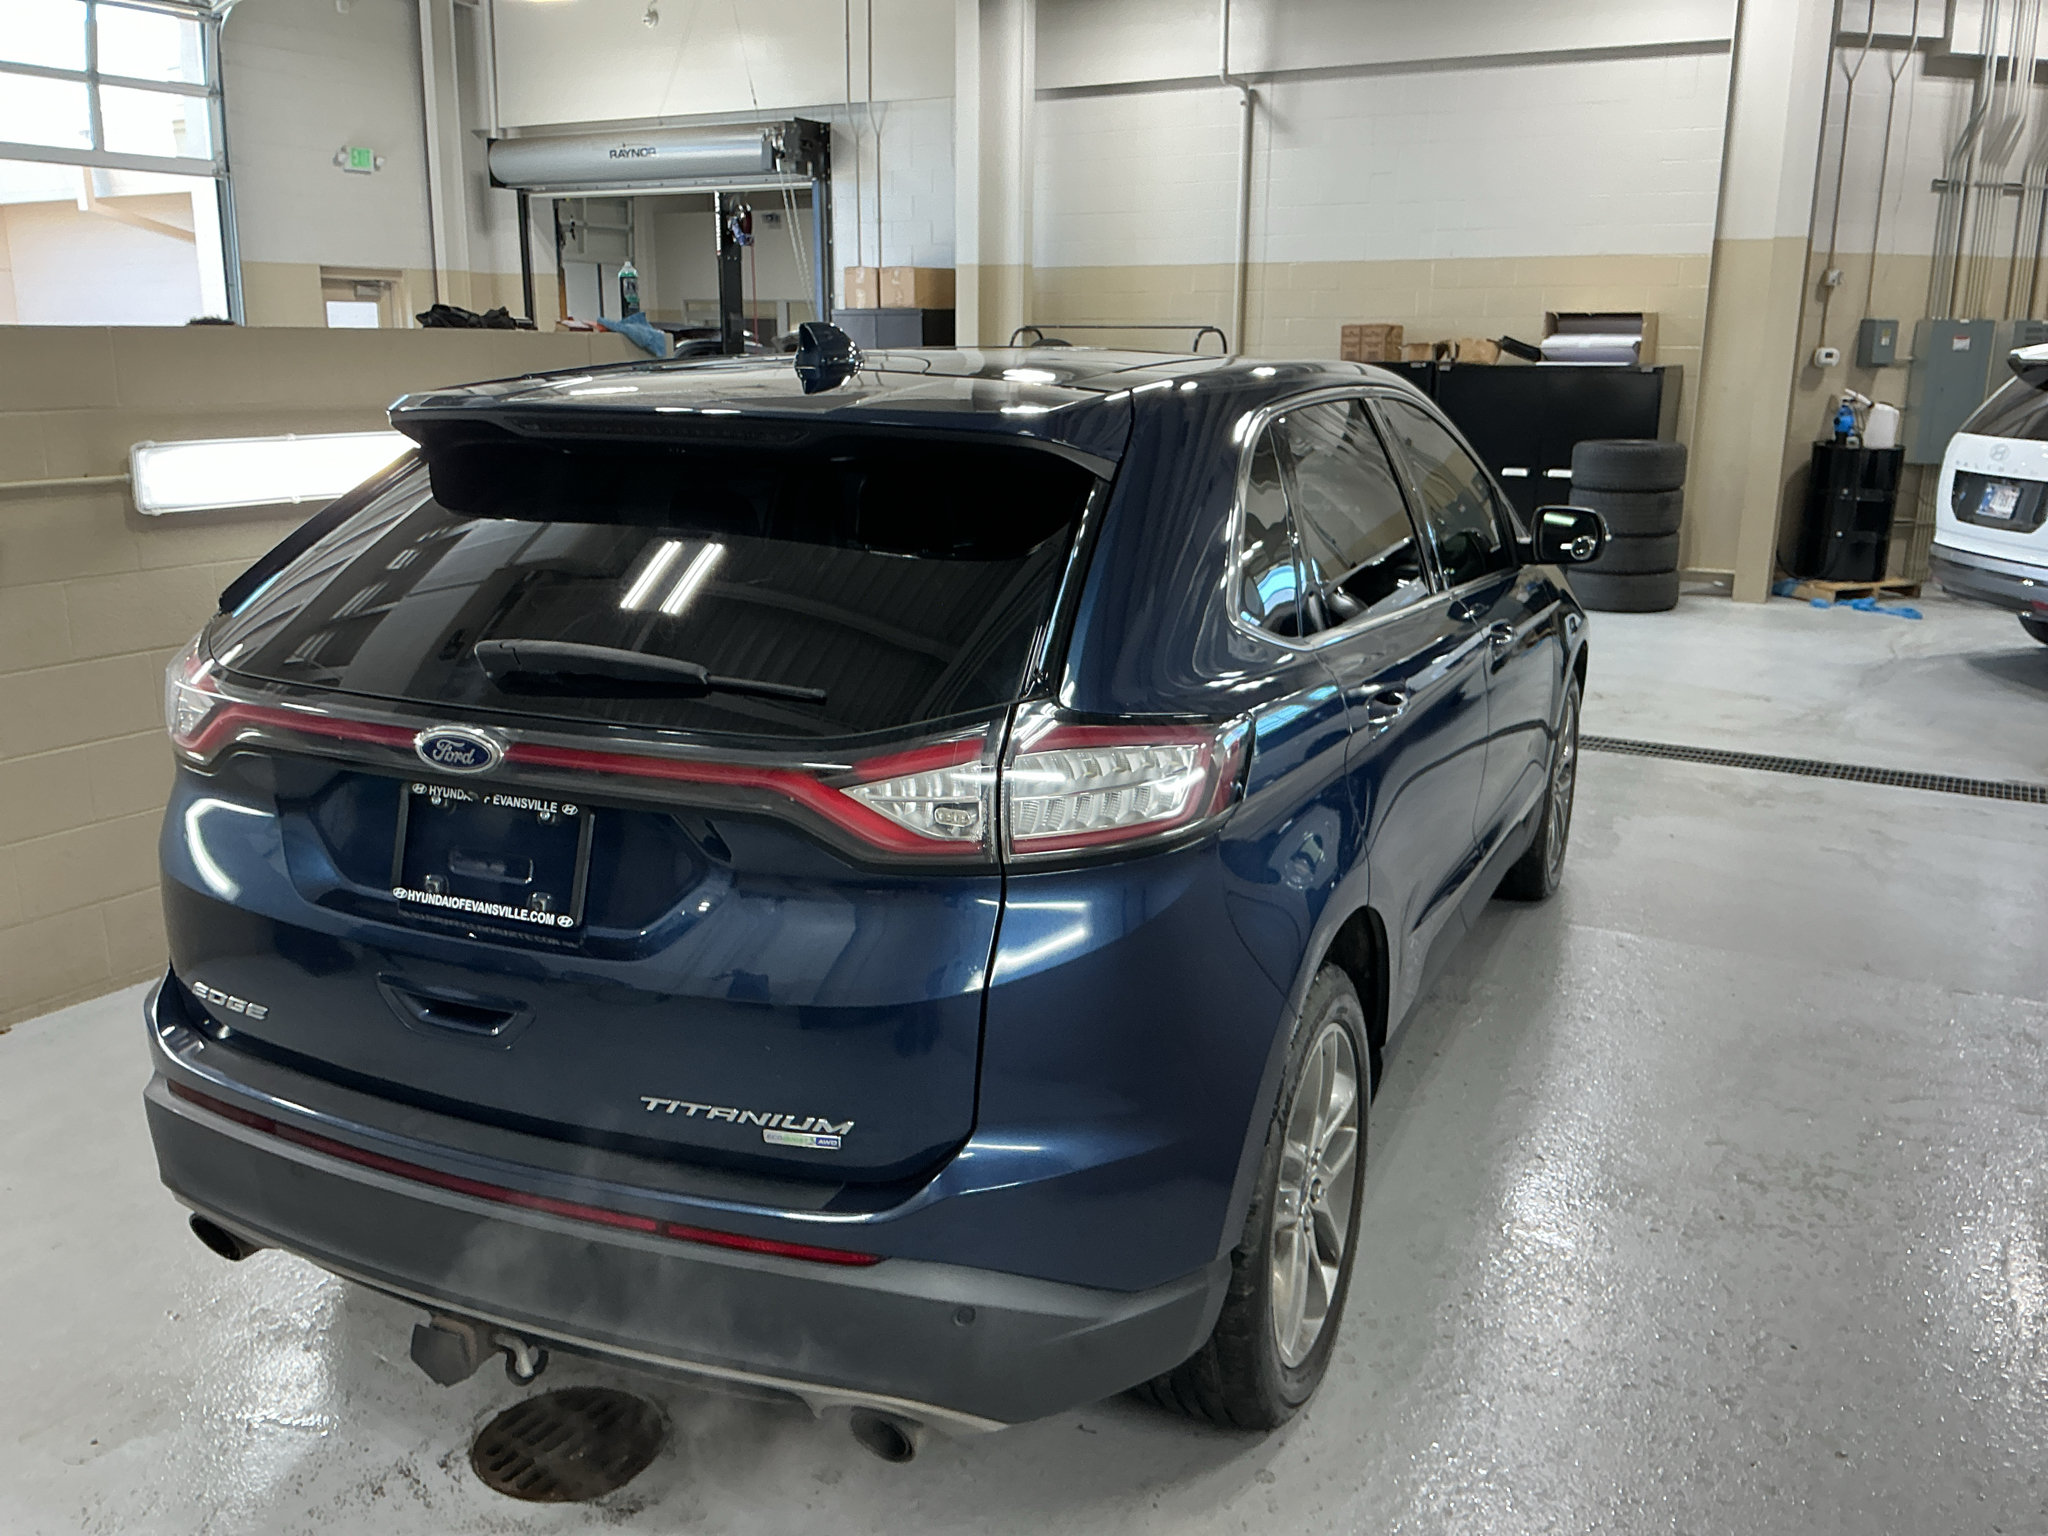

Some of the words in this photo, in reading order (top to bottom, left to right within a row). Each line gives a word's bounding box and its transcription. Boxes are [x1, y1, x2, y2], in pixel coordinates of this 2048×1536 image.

[609, 147, 656, 159] RAYNOR
[432, 739, 479, 765] Ford
[429, 784, 474, 803] HYUND
[492, 793, 558, 814] EVANSVILLE
[407, 889, 555, 925] HYUNDAIOFEVANSVILLE.COM
[192, 981, 269, 1020] EDGE
[640, 1096, 855, 1136] TITANIUM
[817, 1139, 838, 1147] AWD
